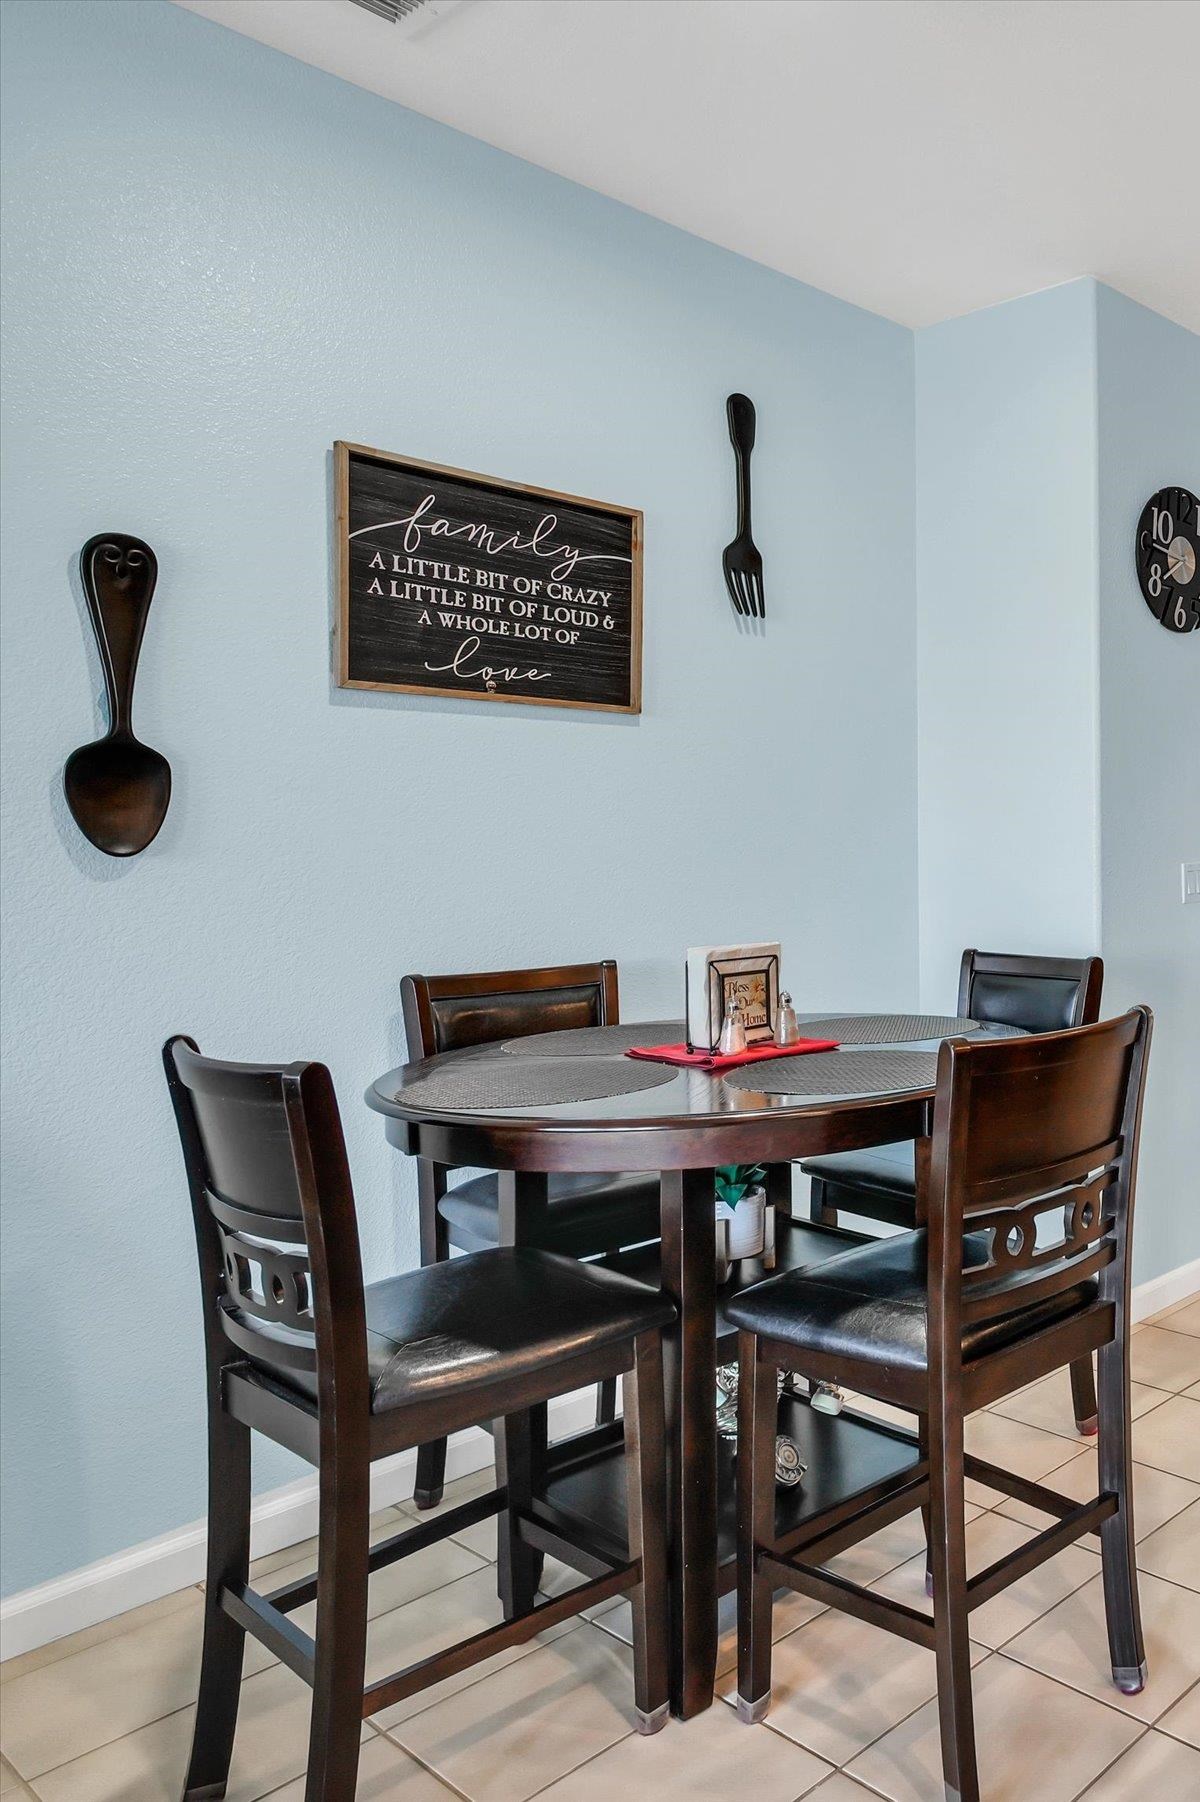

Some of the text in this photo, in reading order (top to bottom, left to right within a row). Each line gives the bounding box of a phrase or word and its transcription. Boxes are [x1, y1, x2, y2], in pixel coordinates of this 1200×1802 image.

[1151, 506, 1174, 544] 10
[1175, 490, 1194, 526] 12
[348, 494, 633, 581] family
[368, 552, 612, 607] A LITTLE BIT OF CRAZY
[1147, 563, 1163, 597] 8
[367, 577, 615, 630] A LITTLE BIT OF LOUD &
[1174, 596, 1187, 629] 6
[418, 609, 580, 645] A WHOLE LOT OF
[424, 636, 552, 681] love
